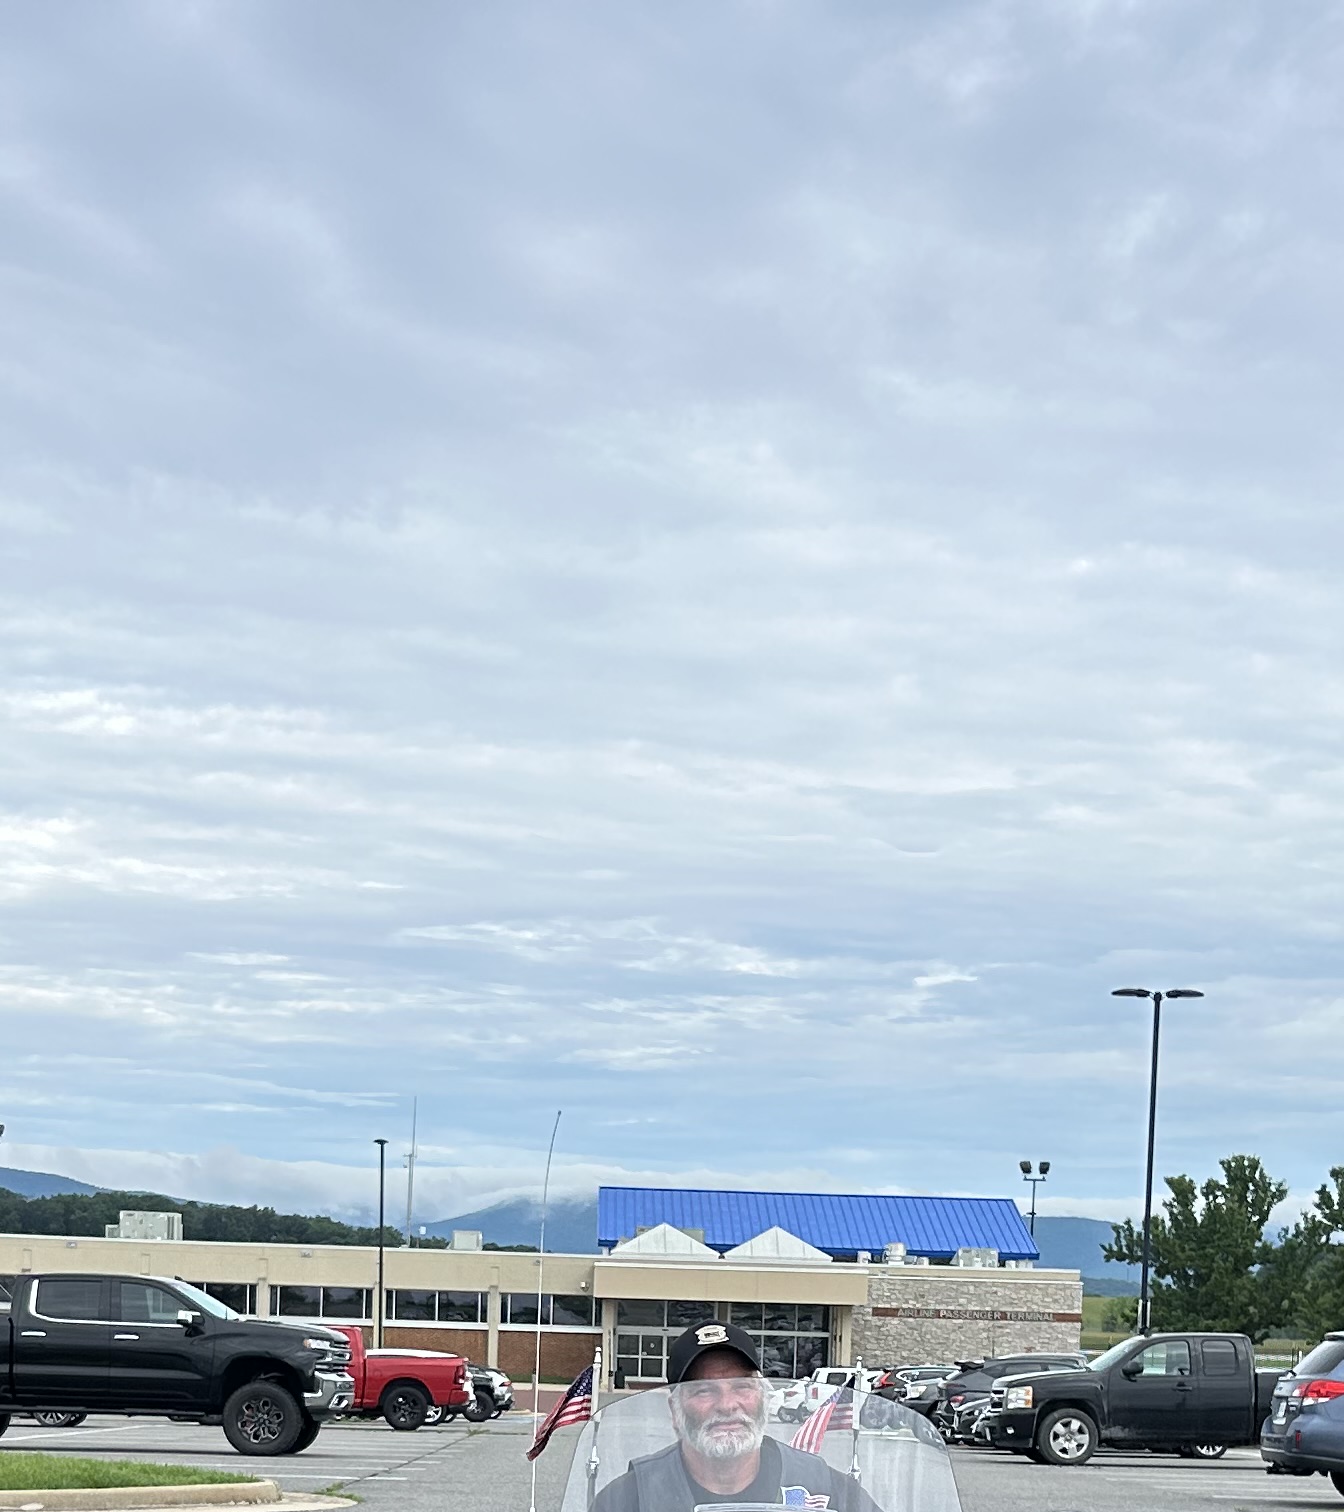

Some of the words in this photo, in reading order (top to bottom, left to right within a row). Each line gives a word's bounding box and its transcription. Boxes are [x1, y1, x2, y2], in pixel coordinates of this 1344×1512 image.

[897, 1307, 936, 1317] AIRLINE
[939, 1308, 1002, 1320] PASSENGER
[1006, 1312, 1054, 1322] TERMINAL
